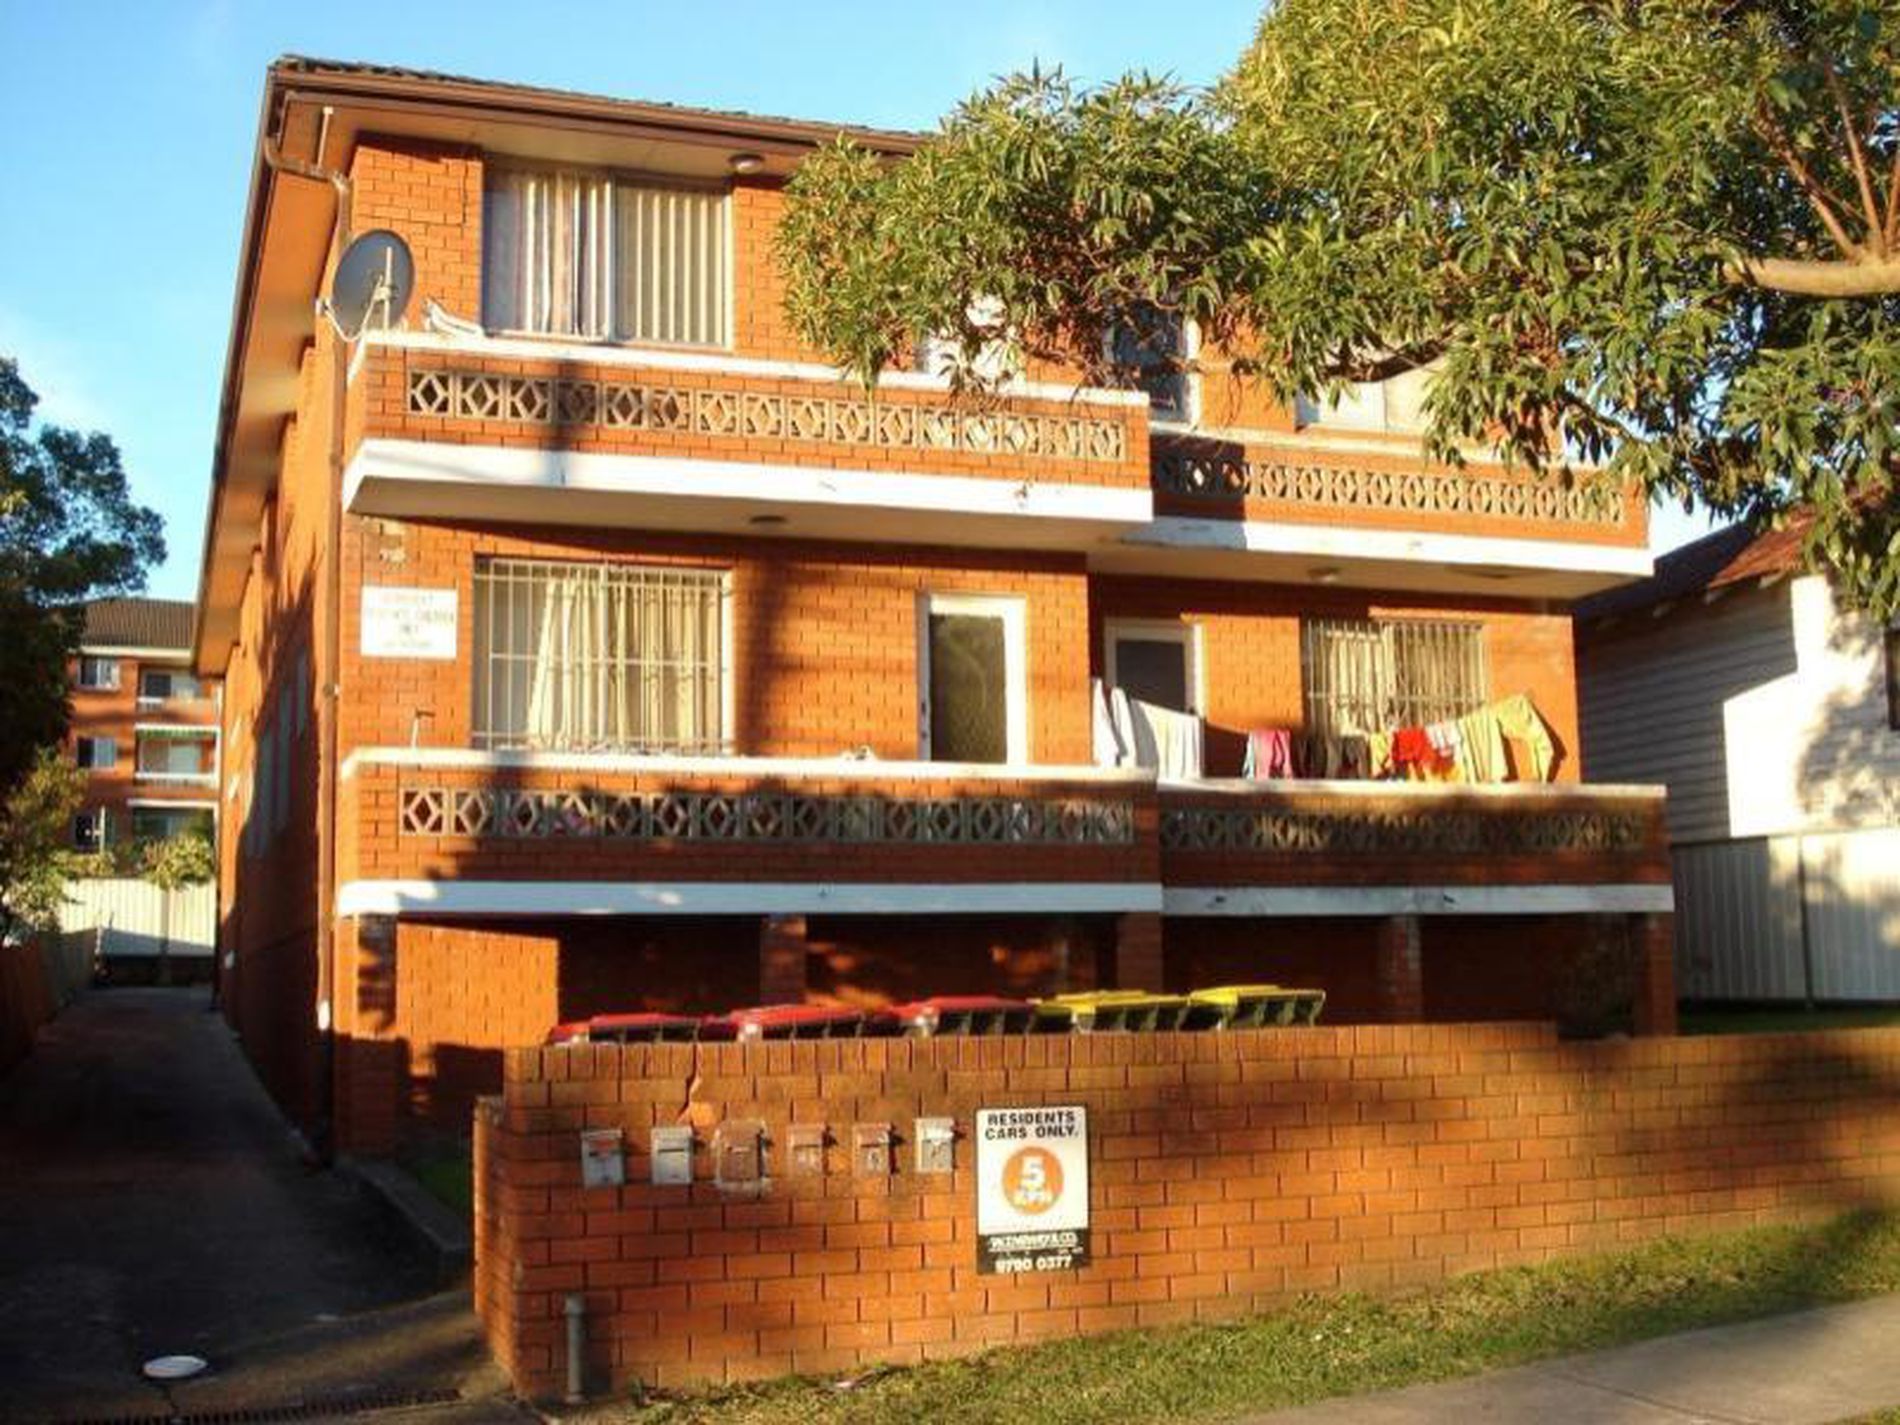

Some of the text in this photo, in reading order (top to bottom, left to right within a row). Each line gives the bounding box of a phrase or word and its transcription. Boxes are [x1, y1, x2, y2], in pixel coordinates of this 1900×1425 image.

[987, 1111, 1075, 1125] RESIDENTS
[985, 1127, 1027, 1140] CARS
[1020, 1156, 1045, 1187] 5
